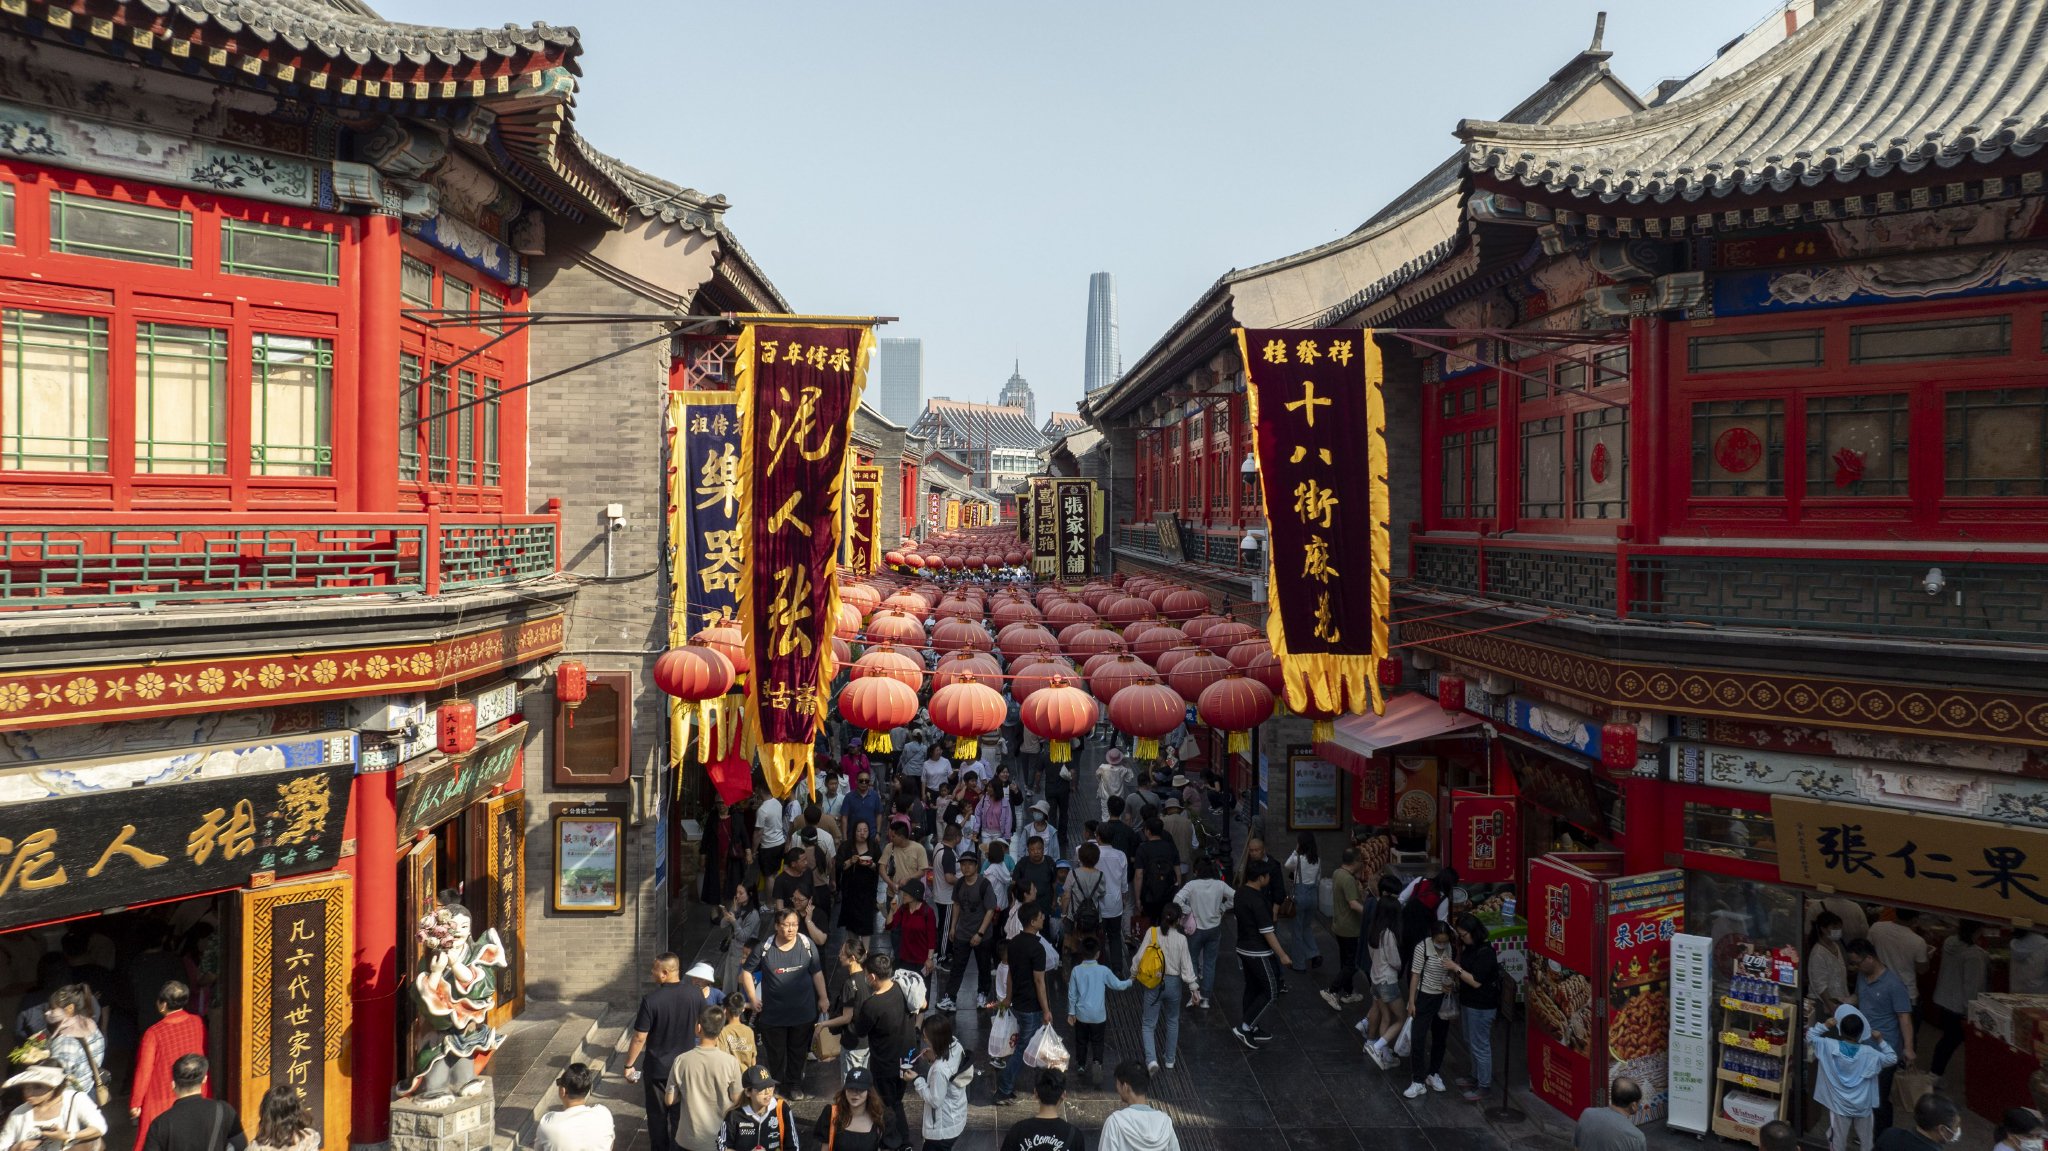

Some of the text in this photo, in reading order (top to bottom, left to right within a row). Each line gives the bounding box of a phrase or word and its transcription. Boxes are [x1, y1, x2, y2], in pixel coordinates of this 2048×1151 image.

[1263, 339, 1353, 367] 桂發祥
[1284, 380, 1342, 643] 十八街麻花
[446, 713, 457, 747] 天津卫
[1614, 916, 1676, 950] 果仁張
[283, 918, 316, 1112] 凡六代世家何
[1033, 1134, 1064, 1151] Coming
